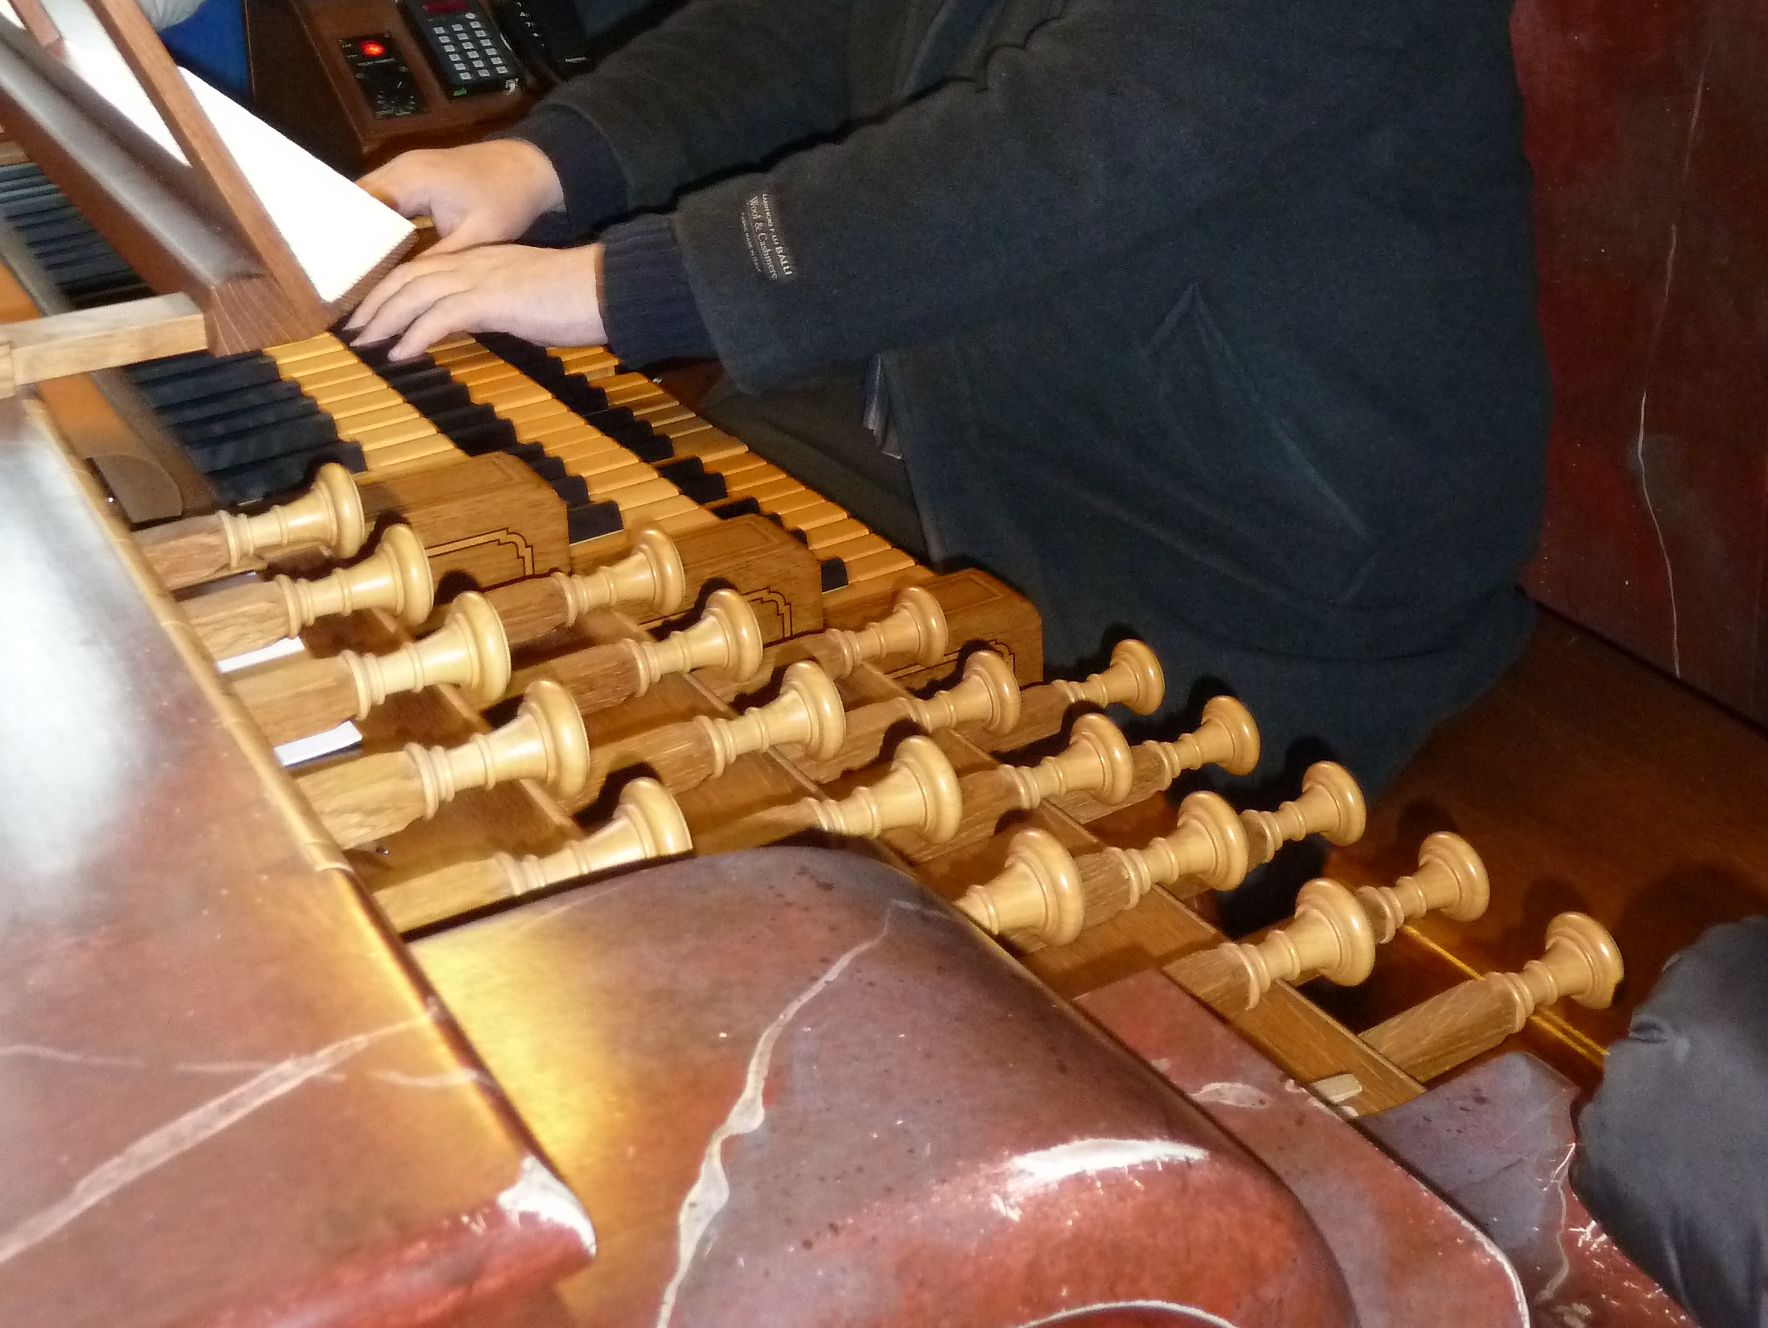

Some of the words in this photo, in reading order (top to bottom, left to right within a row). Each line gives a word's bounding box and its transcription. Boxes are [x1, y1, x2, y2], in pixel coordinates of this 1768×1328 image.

[749, 196, 761, 220] Wool
[755, 222, 763, 232] &
[758, 233, 778, 280] Cashmere
[775, 246, 793, 275] BALLI
